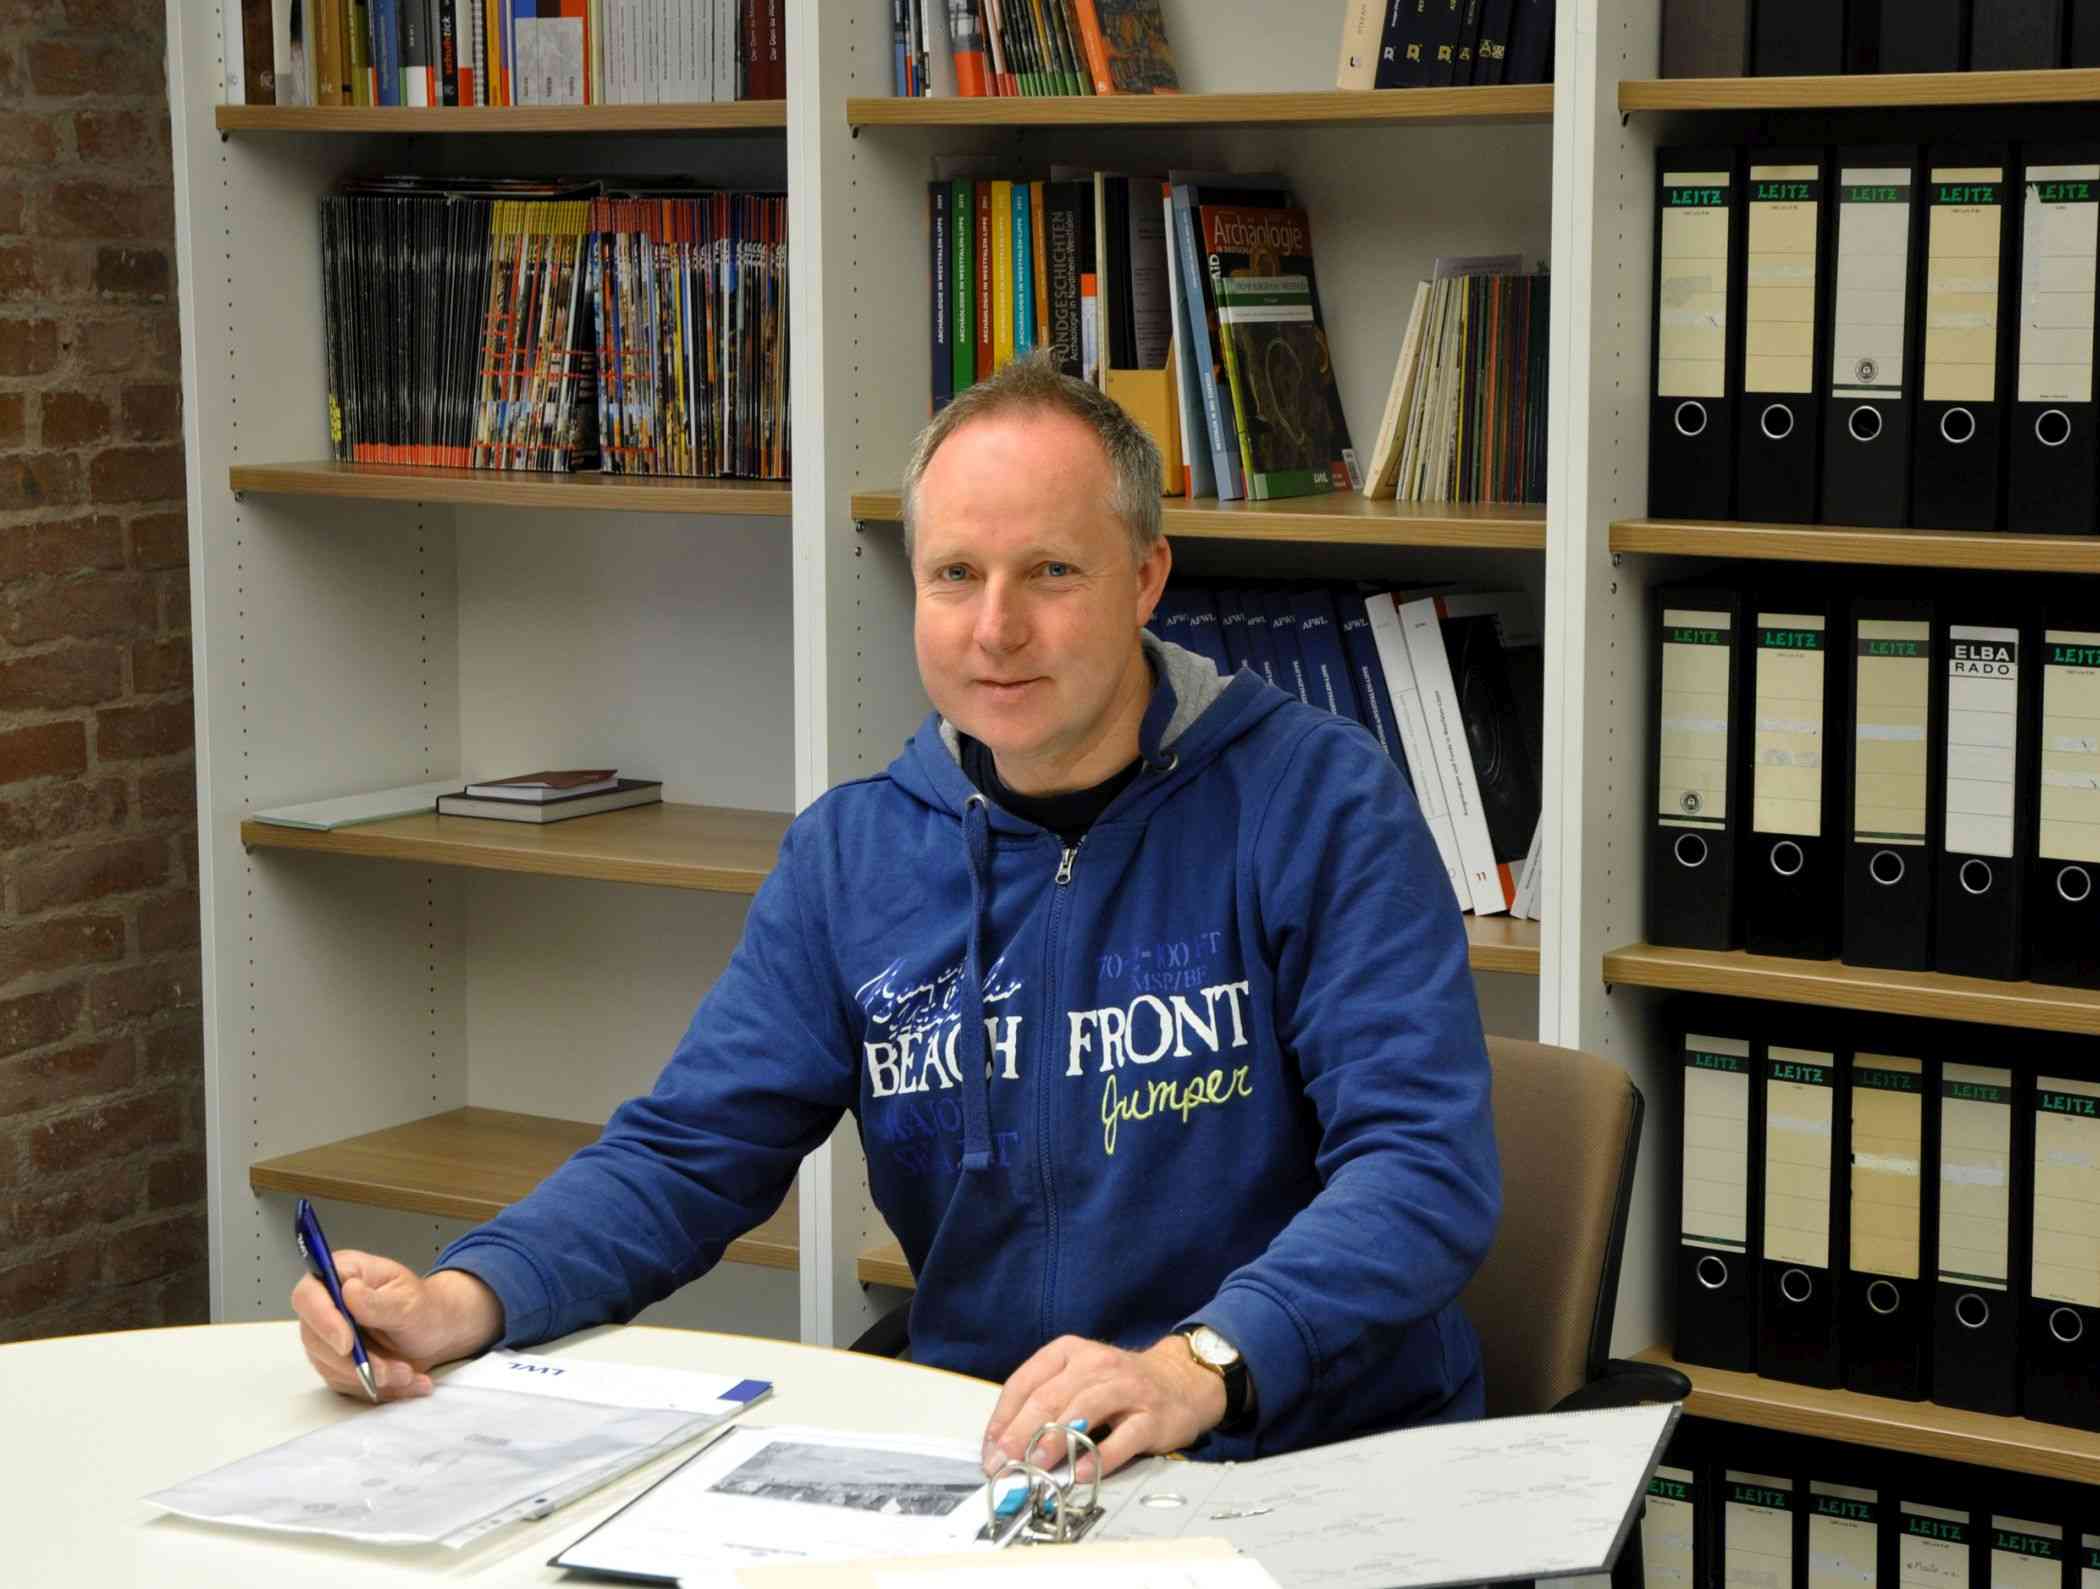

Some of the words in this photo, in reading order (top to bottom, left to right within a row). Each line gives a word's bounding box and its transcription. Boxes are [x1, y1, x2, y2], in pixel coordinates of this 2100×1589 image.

[1672, 189, 1723, 206] LEITZ
[1758, 183, 1809, 200] LEITZ
[1852, 187, 1897, 202] LEITZ
[1940, 187, 1995, 203] LEITZ
[1214, 215, 1304, 256] Archäologie
[1051, 210, 1070, 363] FUNDGESCHICHTEN
[1673, 629, 1720, 645] LEITZ
[1764, 631, 1818, 649] LEITZ
[1868, 641, 1918, 656] LEITZ
[1954, 644, 2011, 662] ELBA
[1954, 662, 2011, 676] RADO
[1064, 980, 1250, 1077] FRONT
[1695, 1053, 1738, 1070] LEITZ
[1773, 1064, 1825, 1083] LEITZ
[1951, 1084, 2001, 1101] LEITZ
[2042, 1093, 2096, 1114] LEITZ
[1647, 1480, 1686, 1499] EITZ
[1734, 1486, 1785, 1507] LEITZ
[1817, 1498, 1870, 1519] LEITZ
[1909, 1518, 1962, 1540] LEITZ
[1996, 1534, 2051, 1555] LEITZ
